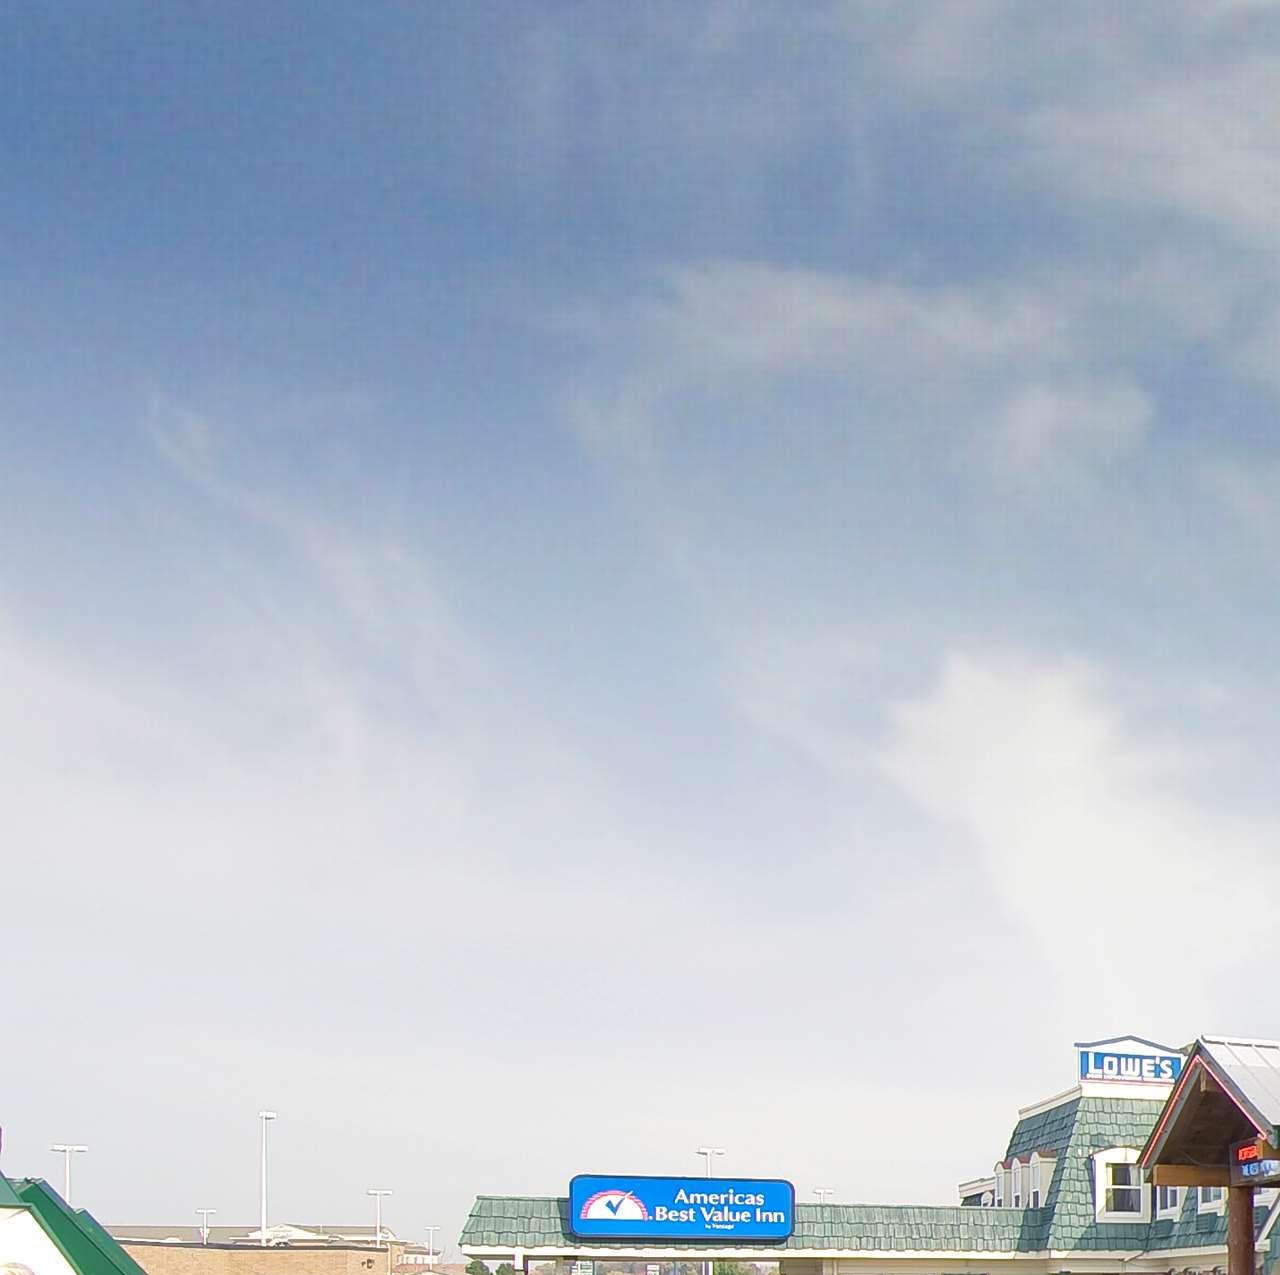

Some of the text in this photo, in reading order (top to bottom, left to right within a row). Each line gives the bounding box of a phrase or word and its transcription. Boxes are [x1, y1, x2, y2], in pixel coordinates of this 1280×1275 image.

[1088, 1052, 1173, 1078] LOWE'S
[674, 1188, 765, 1206] Americas
[655, 1205, 785, 1223] Best Value Inn
